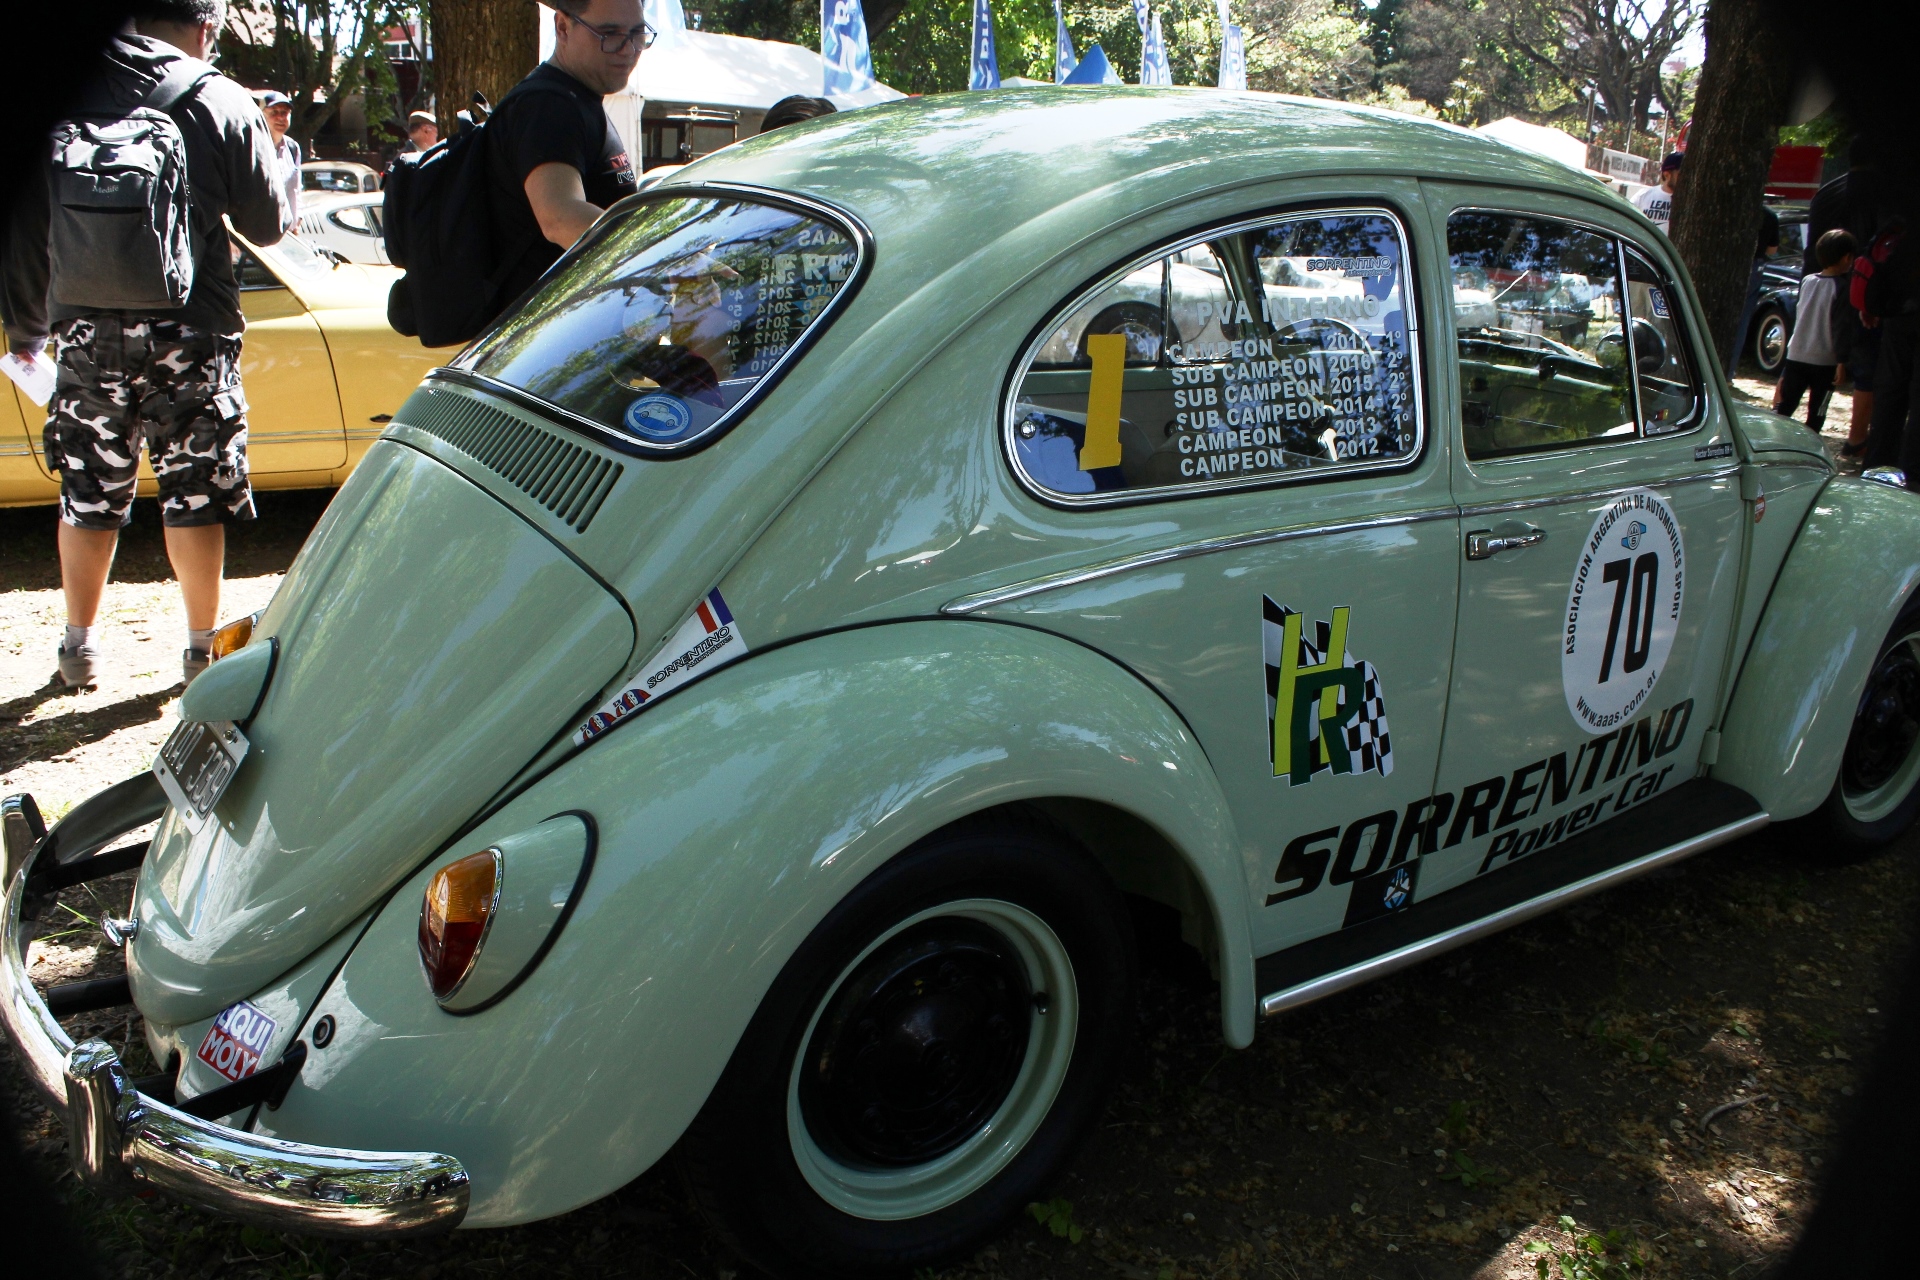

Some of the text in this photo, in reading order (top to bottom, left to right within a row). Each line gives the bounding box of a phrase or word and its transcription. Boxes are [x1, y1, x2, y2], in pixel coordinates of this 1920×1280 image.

[1306, 255, 1392, 272] SORRENTINO
[1197, 294, 1381, 326] PVA INTERNO
[1169, 331, 1401, 362] CAMPEON 2017 1º
[1171, 351, 1404, 386] SUB CAMPEON 2016 2º
[1079, 333, 1127, 471] 1
[1174, 371, 1405, 409] SUB CAMPEON 2015 2º
[1176, 392, 1407, 432] SUB CAMPEON 2014 2º
[1178, 413, 1409, 455] CAMPEON 2013 1º
[1180, 434, 1411, 477] CAMPEON 2012 1º
[1565, 494, 1683, 655] ASOCIACION ARGENTINA DE AUTOMOVILES SPORT
[1598, 551, 1659, 685] 70
[646, 625, 730, 689] SORRENTINO
[1576, 669, 1657, 728] www.aaas.com.ar
[185, 742, 231, 813] 339
[1265, 698, 1694, 907] SORRENTINO
[217, 1004, 272, 1052] LIQUI
[200, 1028, 258, 1079] MOLY
